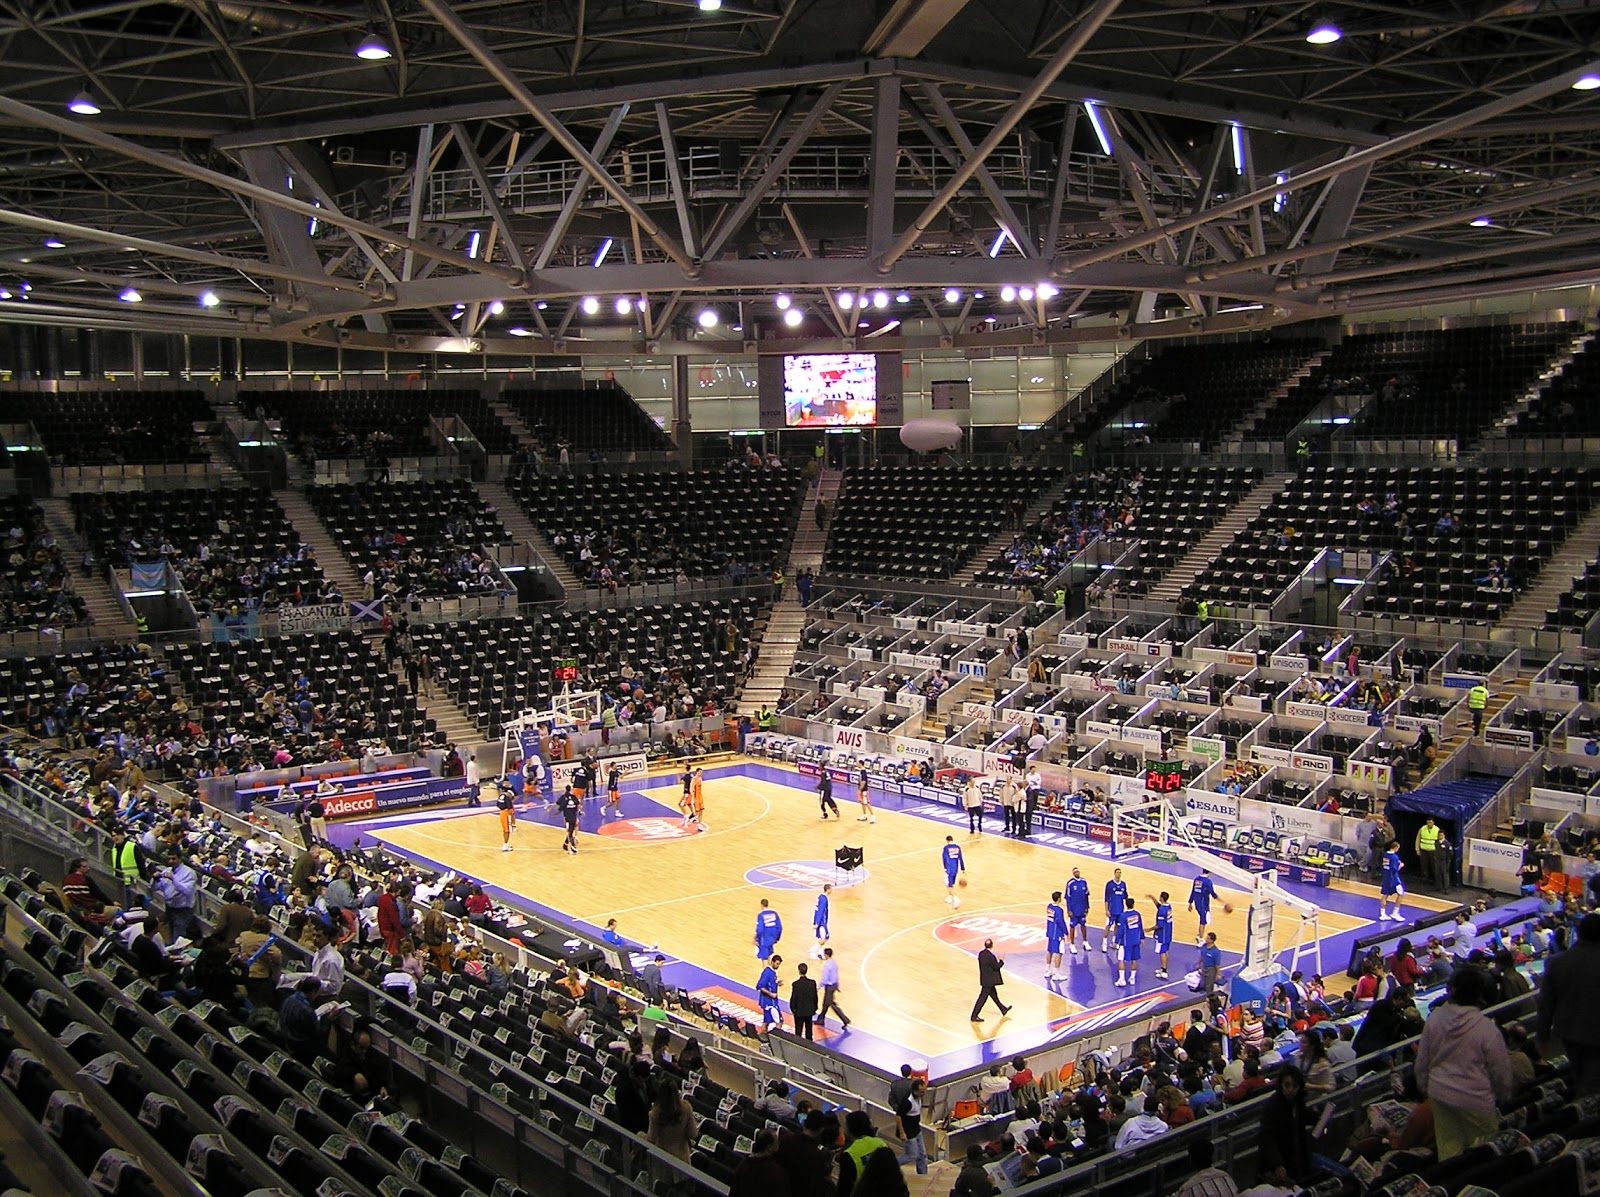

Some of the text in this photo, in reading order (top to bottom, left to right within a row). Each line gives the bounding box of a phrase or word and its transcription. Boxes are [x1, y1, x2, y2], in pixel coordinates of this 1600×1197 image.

[1273, 658, 1304, 669] unisono
[563, 667, 576, 680] 24
[967, 704, 989, 723] Lilly
[1296, 708, 1323, 718] KYOCERA
[1337, 714, 1365, 724] KYOCERA
[836, 730, 863, 748] AVIS
[905, 746, 930, 757] ACTIVA
[951, 755, 969, 767] EADS
[1147, 771, 1165, 789] 24
[1165, 773, 1181, 790] 24
[324, 798, 374, 817] Adecco
[1196, 801, 1236, 816] ESABE
[1287, 817, 1312, 829] Liberty
[1091, 827, 1111, 837] Adecco
[1473, 844, 1521, 859] SIEMENS VDO
